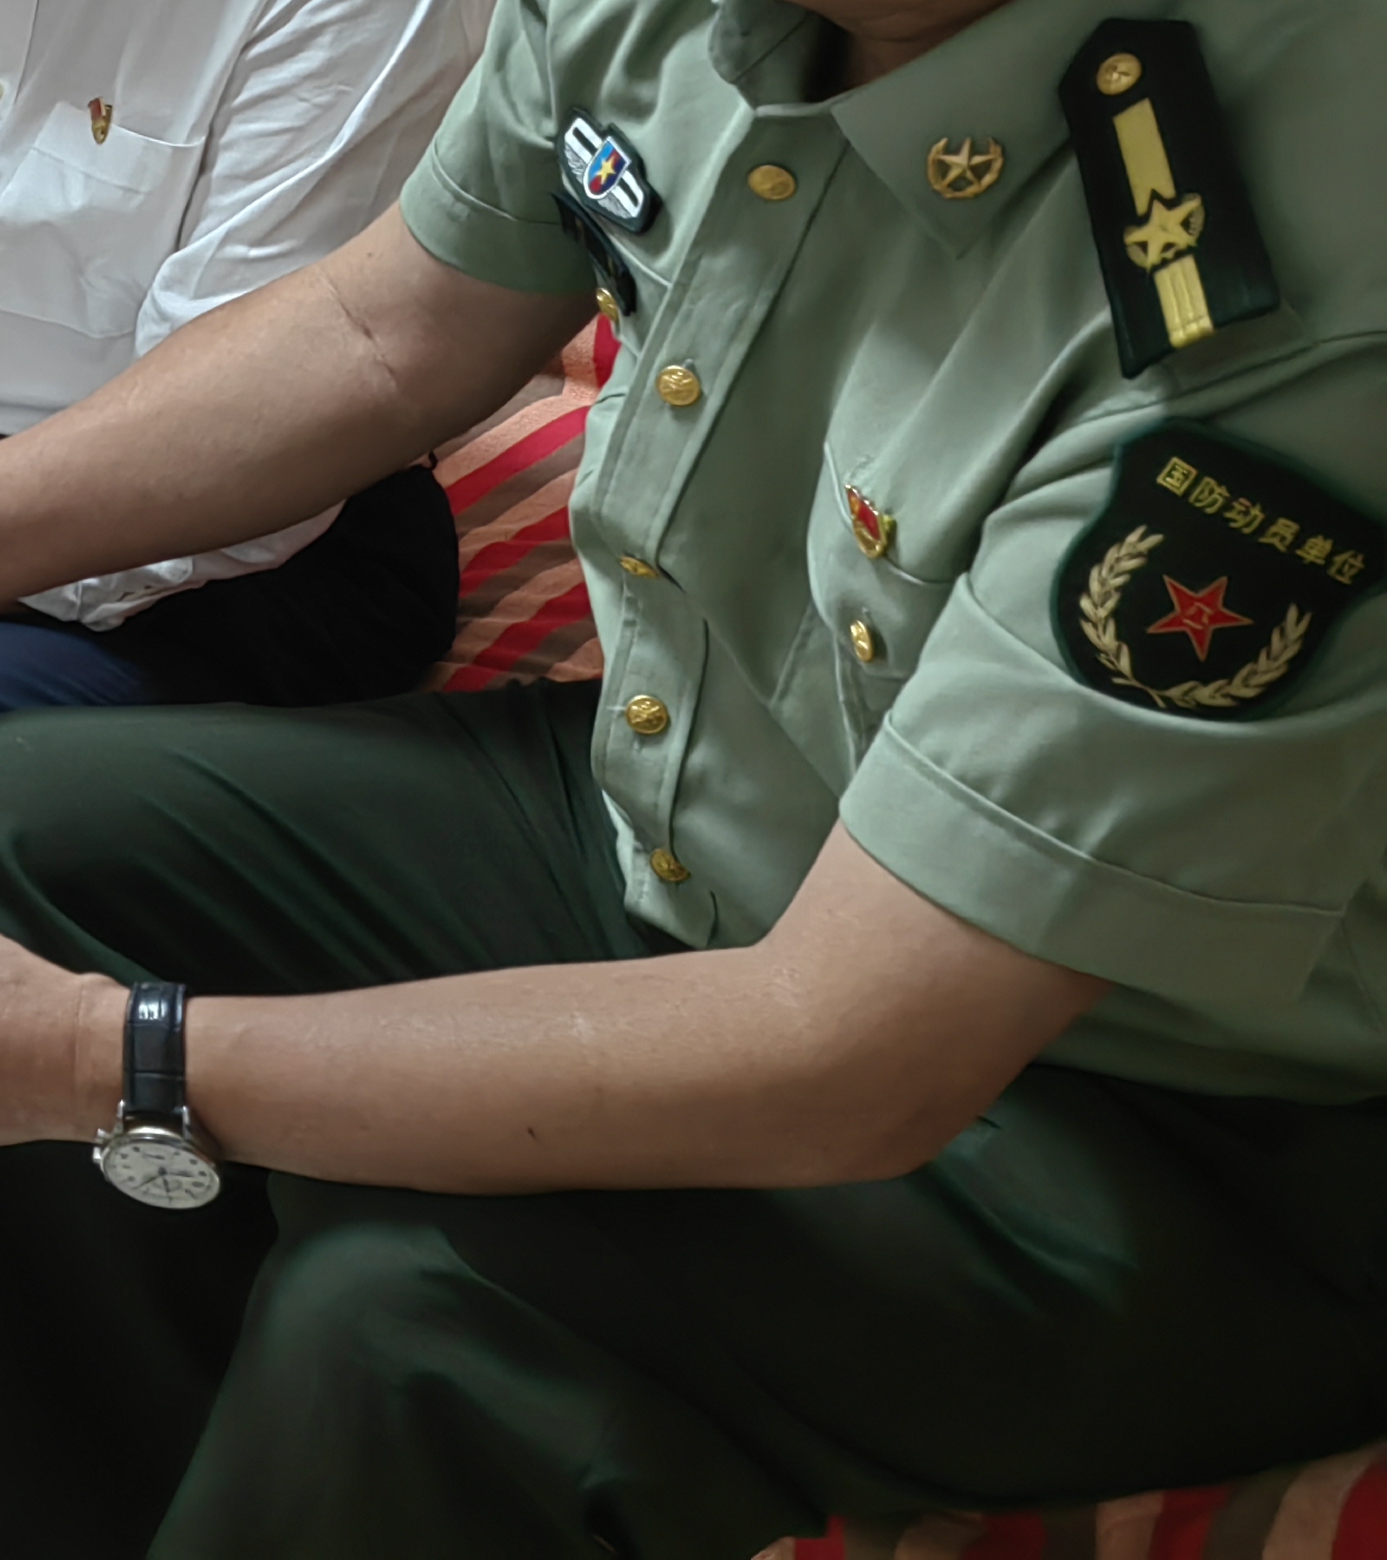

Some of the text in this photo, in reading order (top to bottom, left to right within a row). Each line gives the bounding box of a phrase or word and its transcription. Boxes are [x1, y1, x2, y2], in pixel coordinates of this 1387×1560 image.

[1156, 456, 1365, 585] 国防动员单位
